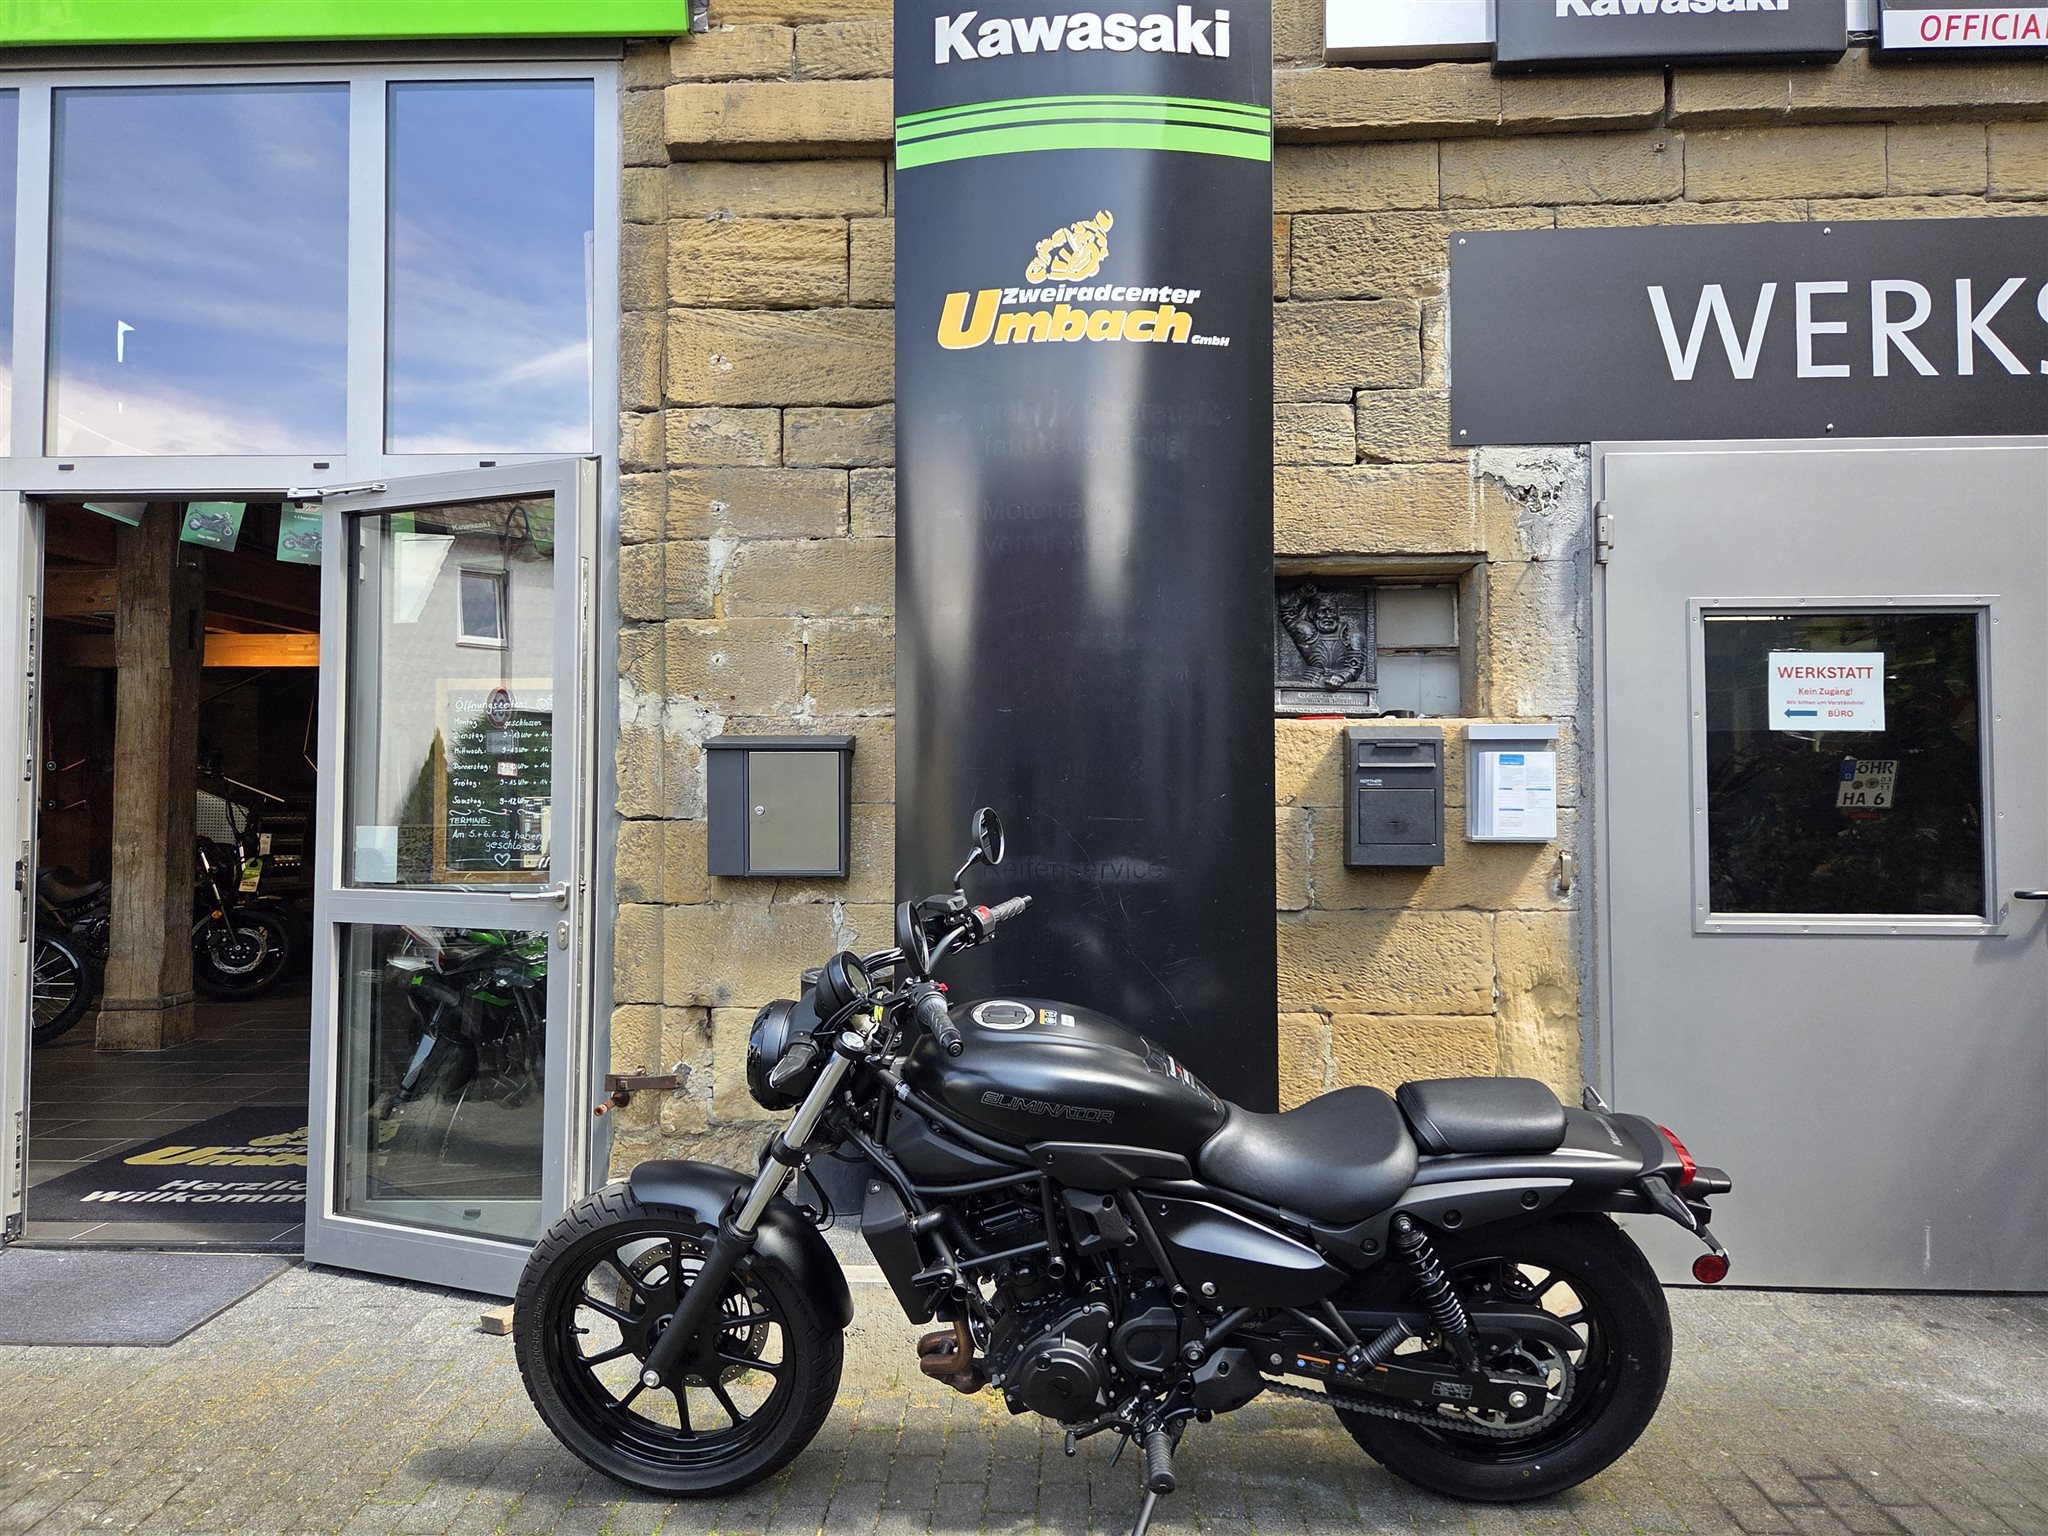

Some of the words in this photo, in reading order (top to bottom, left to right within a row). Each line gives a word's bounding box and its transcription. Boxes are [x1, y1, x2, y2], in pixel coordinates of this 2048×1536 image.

[1920, 13, 2048, 42] OFFICIA
[935, 5, 1230, 64] Kawasaki
[937, 288, 1192, 350] Umbach
[1191, 334, 1230, 348] GmbH
[1648, 277, 2048, 381] WERK
[1777, 666, 1874, 679] WERKSTATT
[1798, 687, 1817, 695] Kein
[1819, 687, 1853, 696] Zugang!
[1828, 709, 1854, 717] BÜRO
[1843, 792, 1866, 806] HA
[1874, 792, 1885, 806] 6
[449, 816, 491, 824] TERMINE:
[452, 829, 465, 839] Am
[514, 830, 543, 840] haben
[485, 839, 543, 852] geschlossen
[980, 1091, 1116, 1124] ELIMINATOR
[80, 1191, 307, 1202] Willkomm
